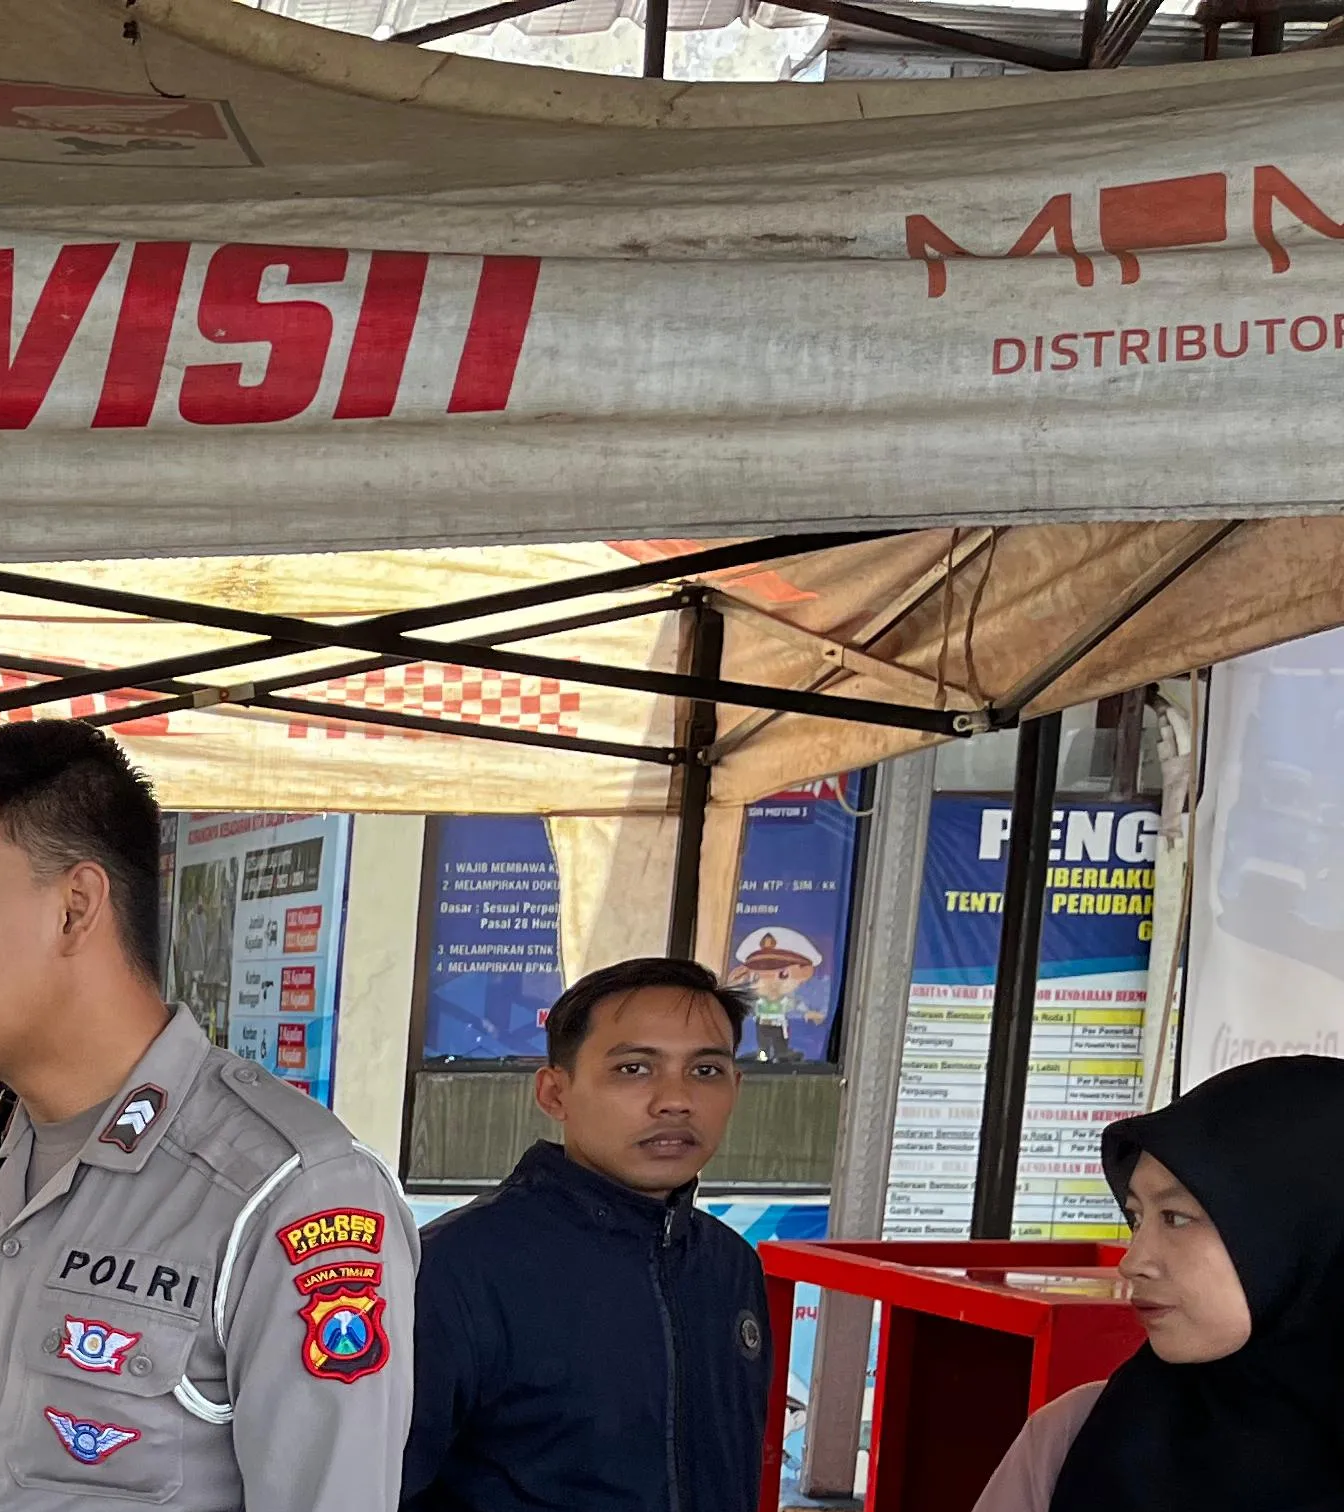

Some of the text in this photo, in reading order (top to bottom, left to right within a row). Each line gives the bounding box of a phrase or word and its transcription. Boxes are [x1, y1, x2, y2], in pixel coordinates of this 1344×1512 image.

[455, 862, 488, 873] WAJIB
[491, 862, 546, 873] MEMBAWA
[454, 880, 530, 891] MELAMPIRKAN
[440, 901, 472, 914] Dasar
[480, 918, 511, 929] Pasal
[449, 944, 524, 956] MELAMPIRKAN
[448, 961, 523, 973] MELAMPIRKAN
[286, 1214, 377, 1250] POLRES
[296, 1230, 373, 1255] JEMBER
[58, 1249, 201, 1309] POLRI
[303, 1269, 339, 1288] JAWA
